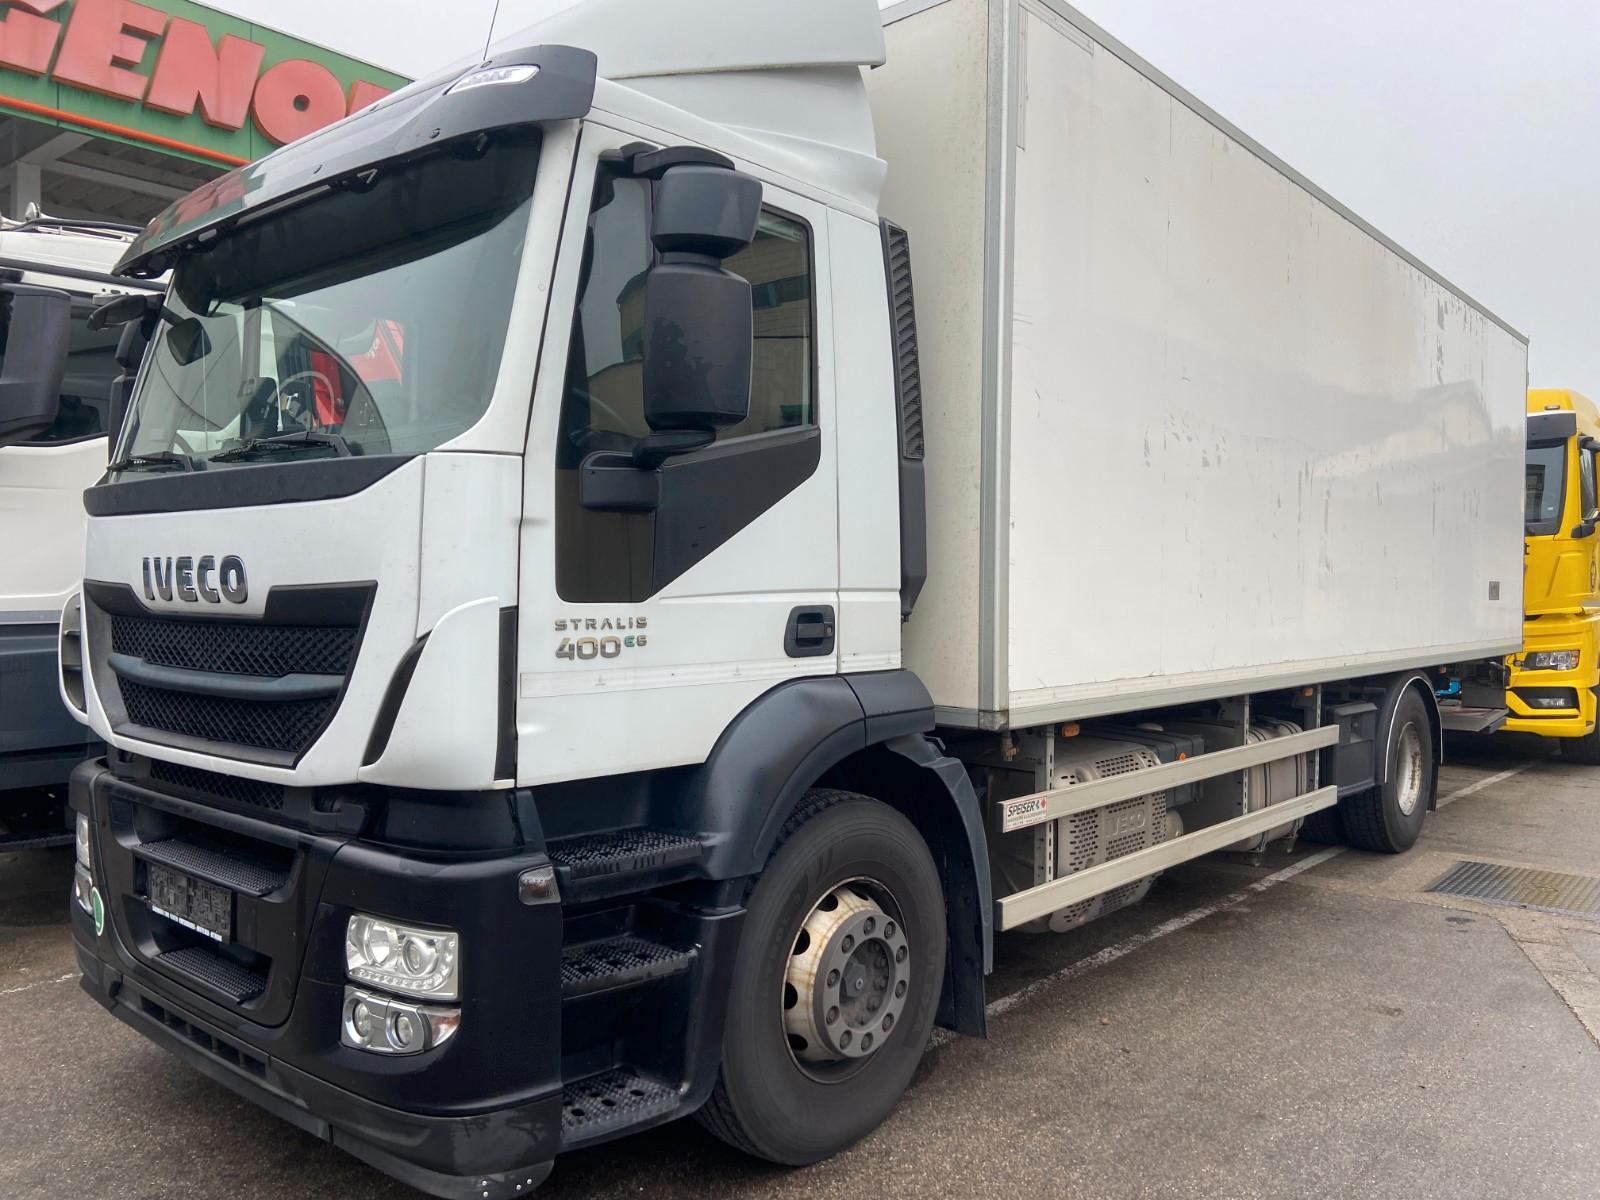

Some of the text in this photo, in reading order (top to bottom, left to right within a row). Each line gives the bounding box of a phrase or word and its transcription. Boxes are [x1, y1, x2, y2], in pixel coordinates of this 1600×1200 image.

[0, 0, 392, 146] GENO
[142, 554, 249, 604] IVECO
[554, 616, 648, 632] STRALIS
[555, 635, 621, 661] 400
[1007, 800, 1036, 818] SPEISER
